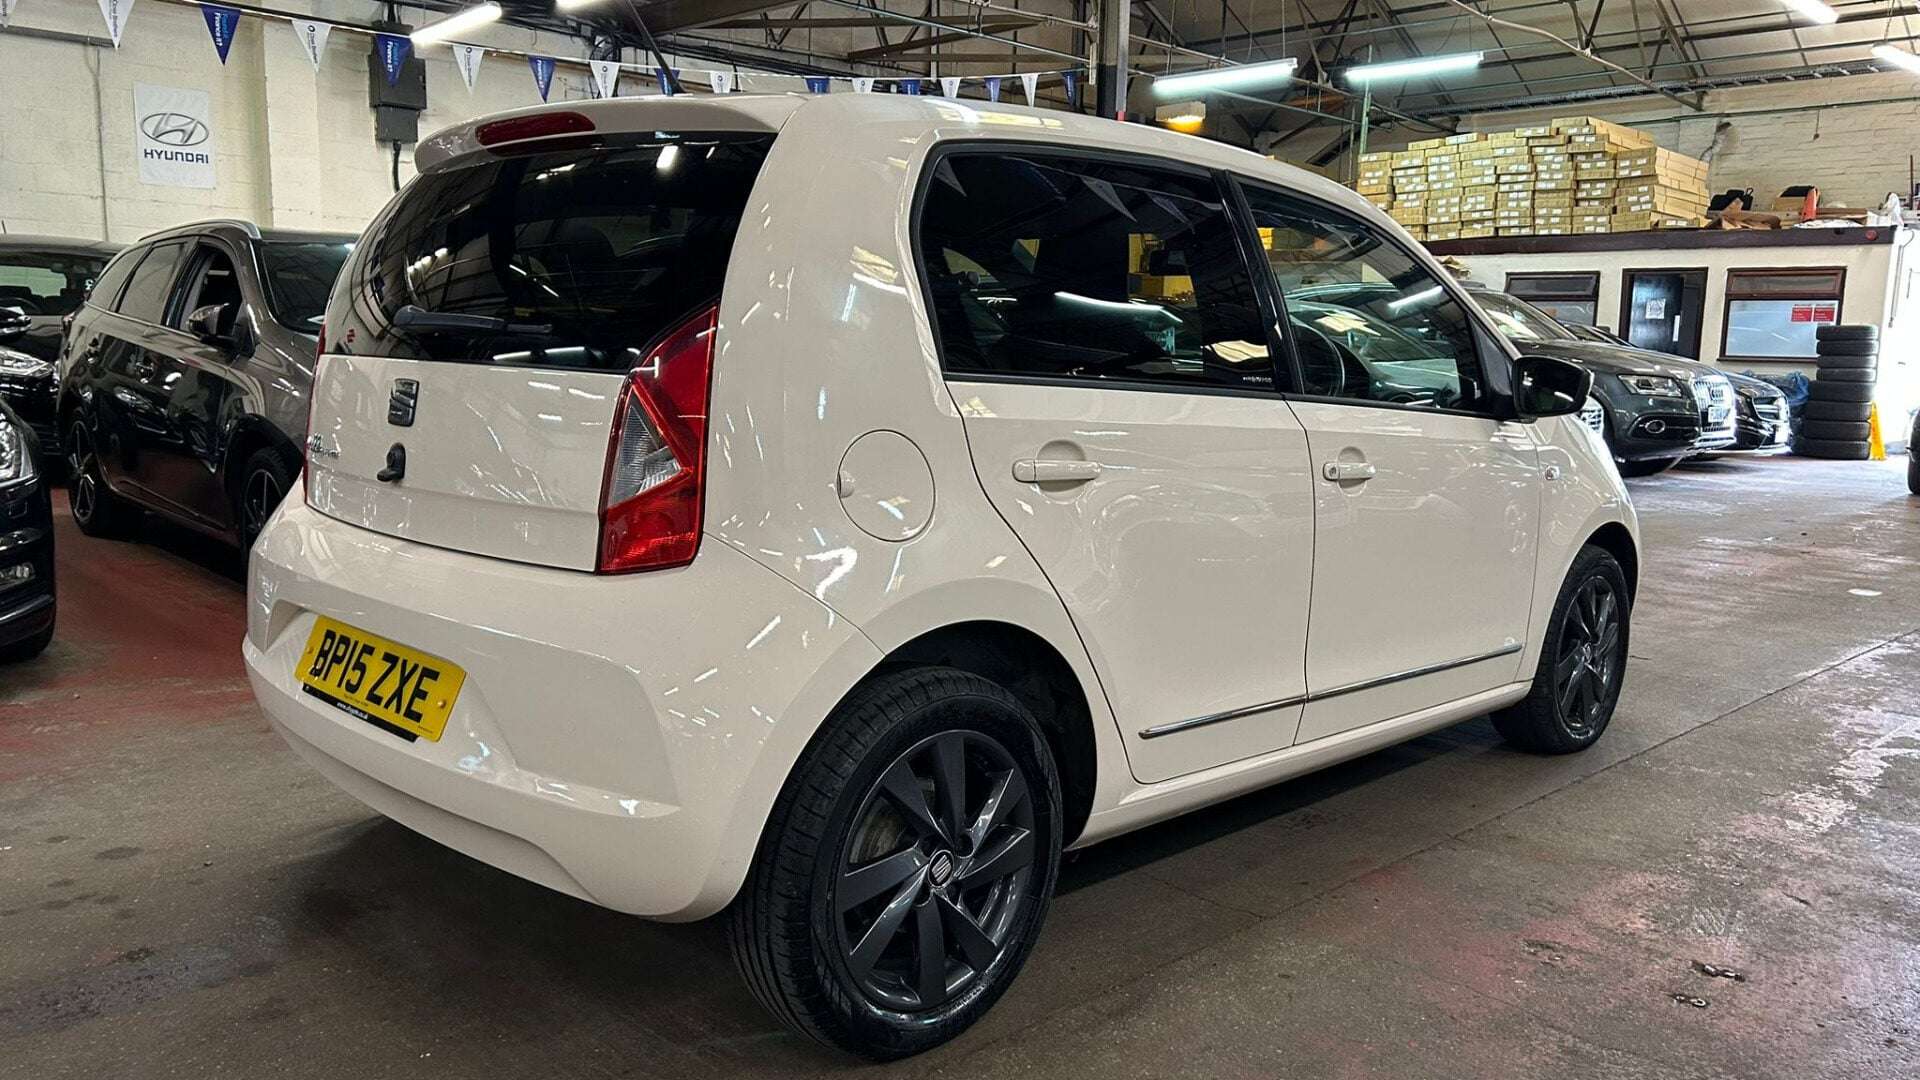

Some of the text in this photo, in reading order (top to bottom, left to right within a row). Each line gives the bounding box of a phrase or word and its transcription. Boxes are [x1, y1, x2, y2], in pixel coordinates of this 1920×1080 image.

[143, 148, 209, 164] HYUNDAI
[309, 629, 440, 723] BP15 ZXE
